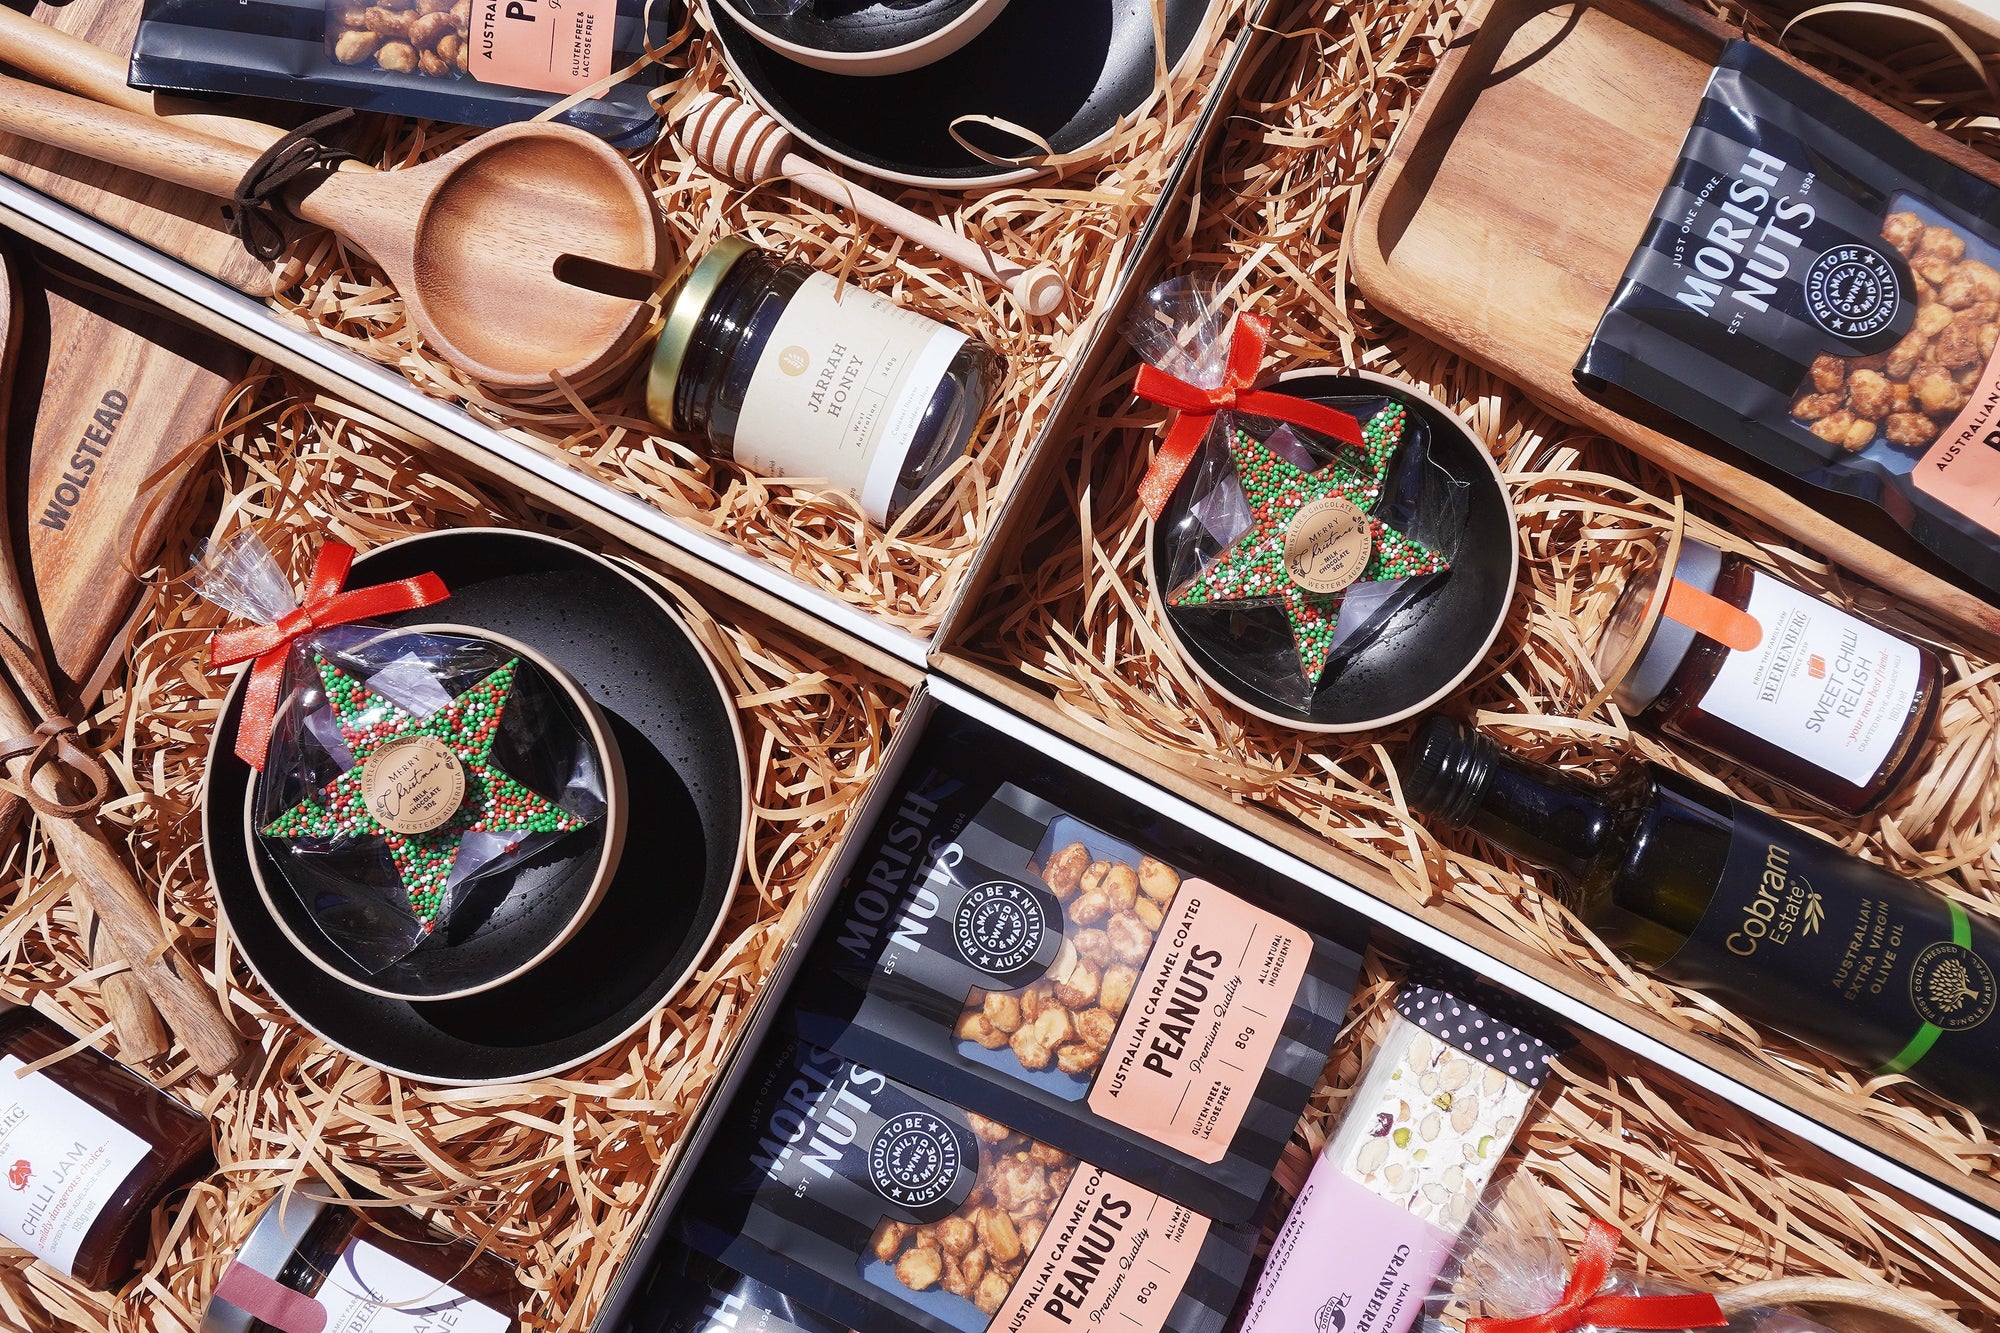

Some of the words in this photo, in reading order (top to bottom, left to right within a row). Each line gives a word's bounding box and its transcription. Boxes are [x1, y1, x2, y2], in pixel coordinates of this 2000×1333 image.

[482, 0, 498, 60] AUSTRA
[575, 18, 584, 39] FREE
[585, 14, 594, 35] FREE
[572, 41, 582, 77] GLUTEN
[582, 38, 592, 78] LACTOSE
[1799, 171, 1816, 196] 1994
[1672, 237, 1687, 269] JUST
[1681, 208, 1698, 234] ONE
[1675, 147, 1788, 318] MORISH
[1730, 195, 1816, 313] NUTS
[1840, 250, 1858, 260] BE
[1819, 255, 1838, 270] TO
[1810, 271, 1832, 319] PROUD
[1830, 268, 1855, 305] FAMILY
[1842, 270, 1867, 312] OWNED
[1847, 265, 1895, 333] AUSTRALIAN
[1853, 305, 1861, 313] &
[1861, 278, 1877, 311] MADE
[1727, 310, 1748, 335] EST.
[807, 343, 847, 413] JARRAH
[827, 354, 864, 418] HONEY
[882, 357, 897, 377] 340g
[853, 412, 865, 432] West
[855, 403, 878, 447] Australian
[1936, 392, 2000, 472] AUSTRALIAN
[39, 390, 128, 531] WOLSTEAD
[1293, 526, 1354, 574] Christmas
[1308, 517, 1339, 543] MERRY
[1308, 580, 1347, 590] WESTERN
[1348, 536, 1369, 580] AUSTRALIA
[1319, 549, 1350, 574] CHOCOLATE
[1324, 550, 1339, 563] MILK
[1752, 665, 1764, 685] FROM
[1761, 650, 1770, 664] THE
[1761, 610, 1808, 703] BEERENBERG
[1791, 655, 1803, 678] SINCE
[1805, 673, 1841, 734] SWEET
[1835, 628, 1859, 674] CHILLI
[1836, 656, 1872, 719] RELISH
[1861, 698, 1874, 718] new
[1868, 676, 1882, 698] best
[1858, 720, 1879, 752] CRAFTED
[376, 762, 440, 817] Christmas
[388, 755, 420, 783] MERRY
[398, 816, 442, 830] WESTERN
[443, 772, 462, 817] AUSTRALIA
[409, 786, 441, 815] CHOCOLATE
[412, 790, 428, 803] MILK
[423, 801, 437, 812] 30g
[950, 813, 966, 836] 1994
[836, 789, 939, 960] MORISH
[886, 834, 964, 953] NUTS
[986, 886, 1003, 897] BE
[966, 892, 983, 907] TO
[977, 903, 1000, 942] FAMILY
[1725, 844, 1790, 957] Cobram
[1768, 885, 1805, 946] Estate
[959, 908, 978, 956] PROUD
[988, 905, 1011, 948] OWNED
[995, 897, 1039, 967] AUSTRALIAN
[999, 941, 1006, 949] &
[1006, 912, 1021, 945] MADE
[1832, 898, 1873, 990] AUSTRALIAN
[883, 952, 901, 976] EST.
[1258, 966, 1269, 985] ALL
[1265, 934, 1283, 967] NATURAL
[1269, 938, 1292, 987] INGREDIENTS
[1844, 956, 1877, 1001] EXTRA
[1869, 900, 1889, 950] VIRGIN
[1870, 948, 1897, 994] OLIVE
[1890, 922, 1905, 947] OIL
[1923, 946, 1958, 965] PRESSED
[1108, 1017, 1151, 1098] AUSTRALIAN
[1144, 954, 1179, 1016] CARAMEL
[1173, 898, 1201, 948] COATED
[1915, 966, 1926, 992] COLD
[1950, 1007, 1986, 1026] SINGLE
[1971, 957, 1992, 1006] VARIETAL
[1143, 944, 1223, 1078] PEANUTS
[1189, 1020, 1222, 1074] Premium
[1213, 975, 1242, 1018] Quality
[1916, 996, 1936, 1019] FIRST
[1235, 1026, 1256, 1050] 80g
[748, 1044, 846, 1182] MORIS
[800, 1063, 886, 1180] NUTS
[1192, 1106, 1211, 1136] GLUTEN
[1205, 1087, 1220, 1106] FREE
[1201, 1106, 1222, 1140] LACTOSE
[1217, 1085, 1231, 1106] FREE
[874, 1139, 891, 1187] PROUD
[884, 1122, 902, 1138] TO
[905, 1118, 922, 1128] BE
[892, 1136, 918, 1175] FAMILY
[901, 1138, 928, 1181] OWNED
[906, 1132, 955, 1202] AUSTRALIAN
[912, 1174, 920, 1183] &
[920, 1146, 937, 1180] MADE
[21, 1184, 56, 1236] CHILLI
[52, 1141, 88, 1184] JAM
[48, 1175, 81, 1221] dangerous
[794, 1176, 813, 1199] EST.
[64, 1209, 74, 1222] THE
[1165, 1223, 1176, 1240] ALL
[1265, 1184, 1314, 1280] CRANBERRY
[1008, 1262, 1056, 1333] AUSTRALIAN
[1051, 1198, 1090, 1261] CARAMEL
[1085, 1167, 1106, 1195] COA
[1043, 1193, 1132, 1325] PEANUTS
[1265, 1220, 1305, 1297] HANDCRAFTED
[1089, 1274, 1126, 1324] Premium
[1119, 1228, 1149, 1270] Quality
[1137, 1281, 1158, 1305] 80g
[1354, 1244, 1410, 1333] CRANBERR
[1251, 1298, 1267, 1326] SOFT
[1321, 1299, 1336, 1330] MONDO
[1380, 1282, 1411, 1333] HANDCRA
